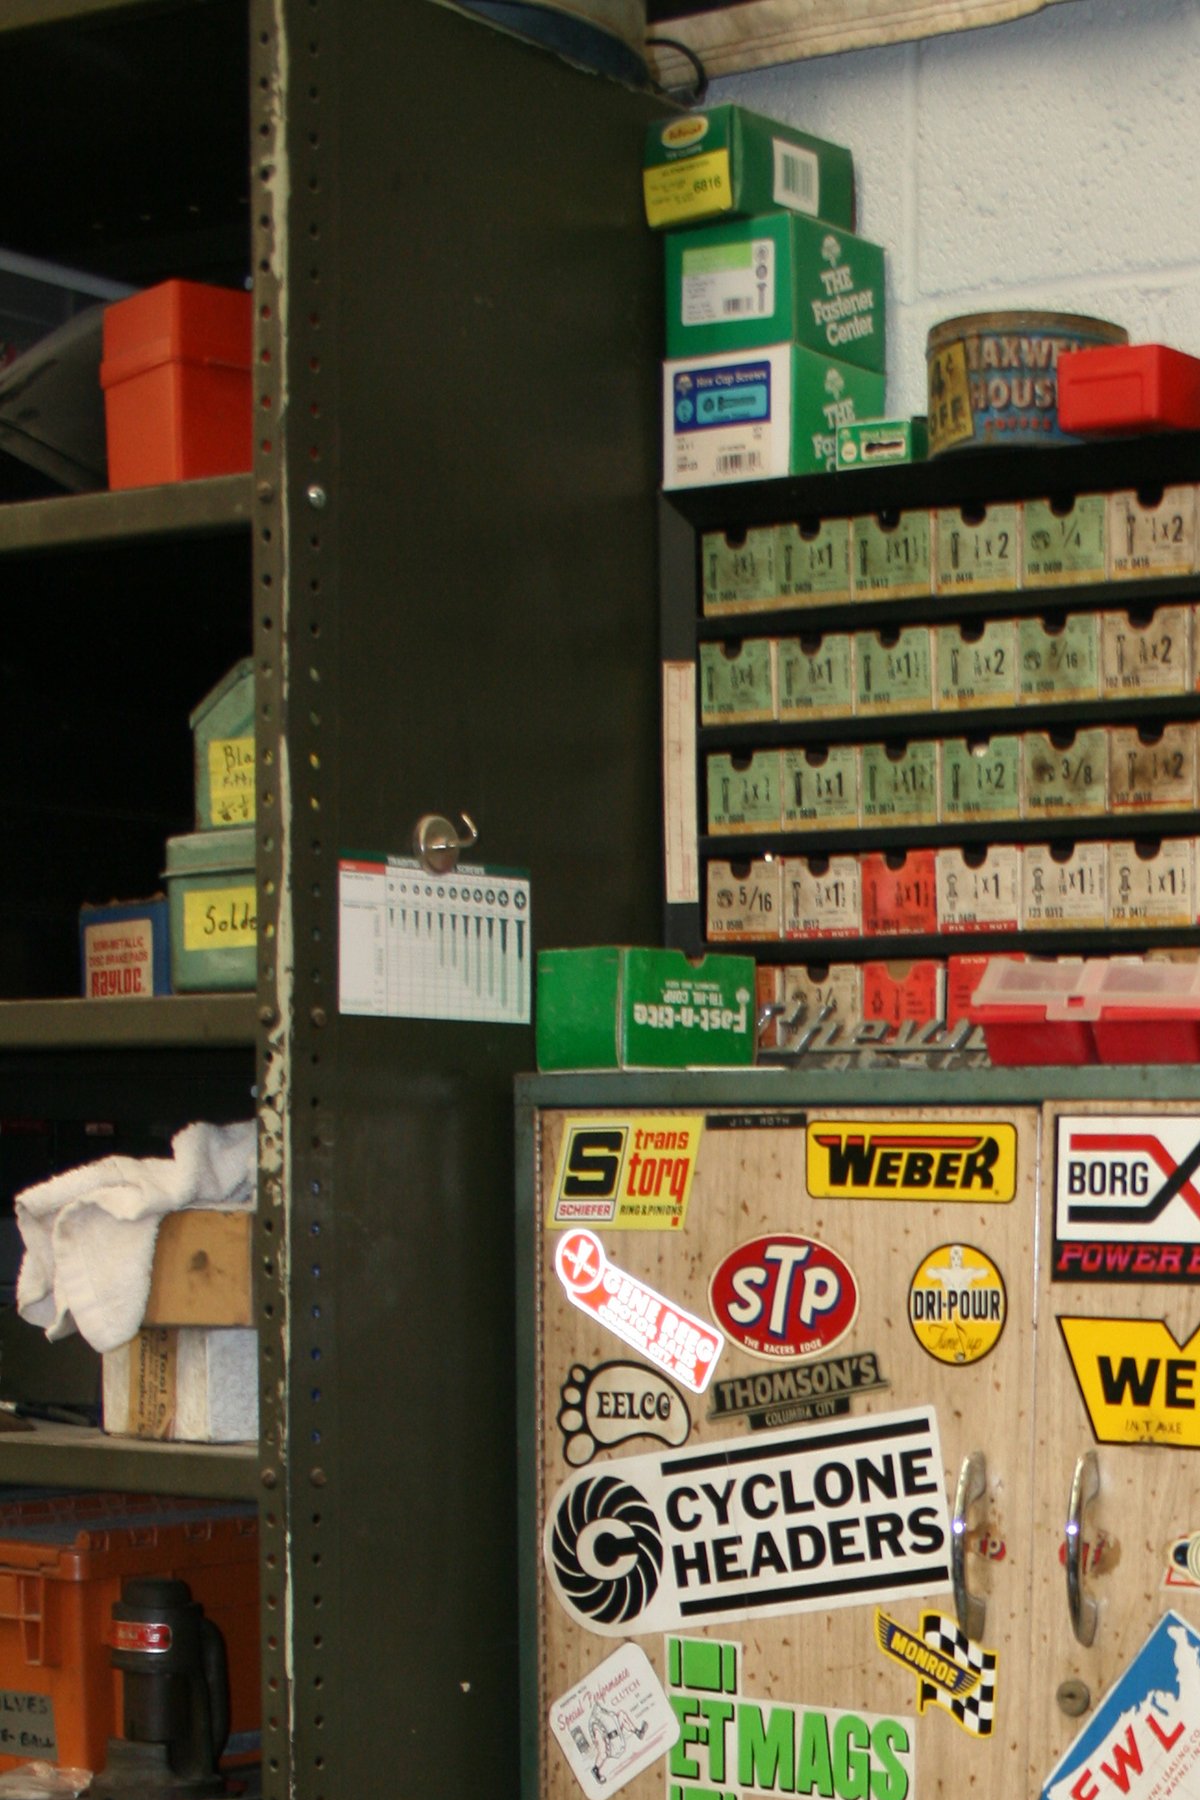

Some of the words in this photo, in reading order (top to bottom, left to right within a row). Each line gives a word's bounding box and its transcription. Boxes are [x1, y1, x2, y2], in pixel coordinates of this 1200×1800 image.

[820, 267, 853, 296] THE
[812, 291, 875, 326] Fastener
[825, 312, 875, 348] Center
[822, 398, 856, 430] THE
[634, 1003, 747, 1034] Fast-n-tite
[635, 1128, 689, 1150] trans
[628, 1152, 690, 1204] torq
[813, 1133, 1000, 1190] WEBER
[1067, 1162, 1149, 1196] BORG
[558, 1202, 611, 1217] SCHIEFER
[1057, 1243, 1183, 1273] POWER
[602, 1267, 662, 1321] GENE
[727, 1244, 841, 1336] STP
[913, 1289, 1000, 1320] DRI-POWR
[744, 1334, 760, 1350] THE
[763, 1343, 795, 1355] RACERS
[798, 1338, 823, 1354] EDGE
[719, 1356, 875, 1410] THOMSON'S
[596, 1392, 671, 1420] EELCO
[814, 1401, 836, 1418] CITY
[1125, 1419, 1182, 1435] INTAKE
[666, 1448, 938, 1532] CYCLONE
[671, 1507, 945, 1589] HEADERS
[889, 1630, 959, 1689] MONROE
[610, 1679, 641, 1707] CLUTCH
[557, 1700, 584, 1732] Special
[669, 1695, 735, 1783] ET
[1162, 1746, 1191, 1784] LEASING
